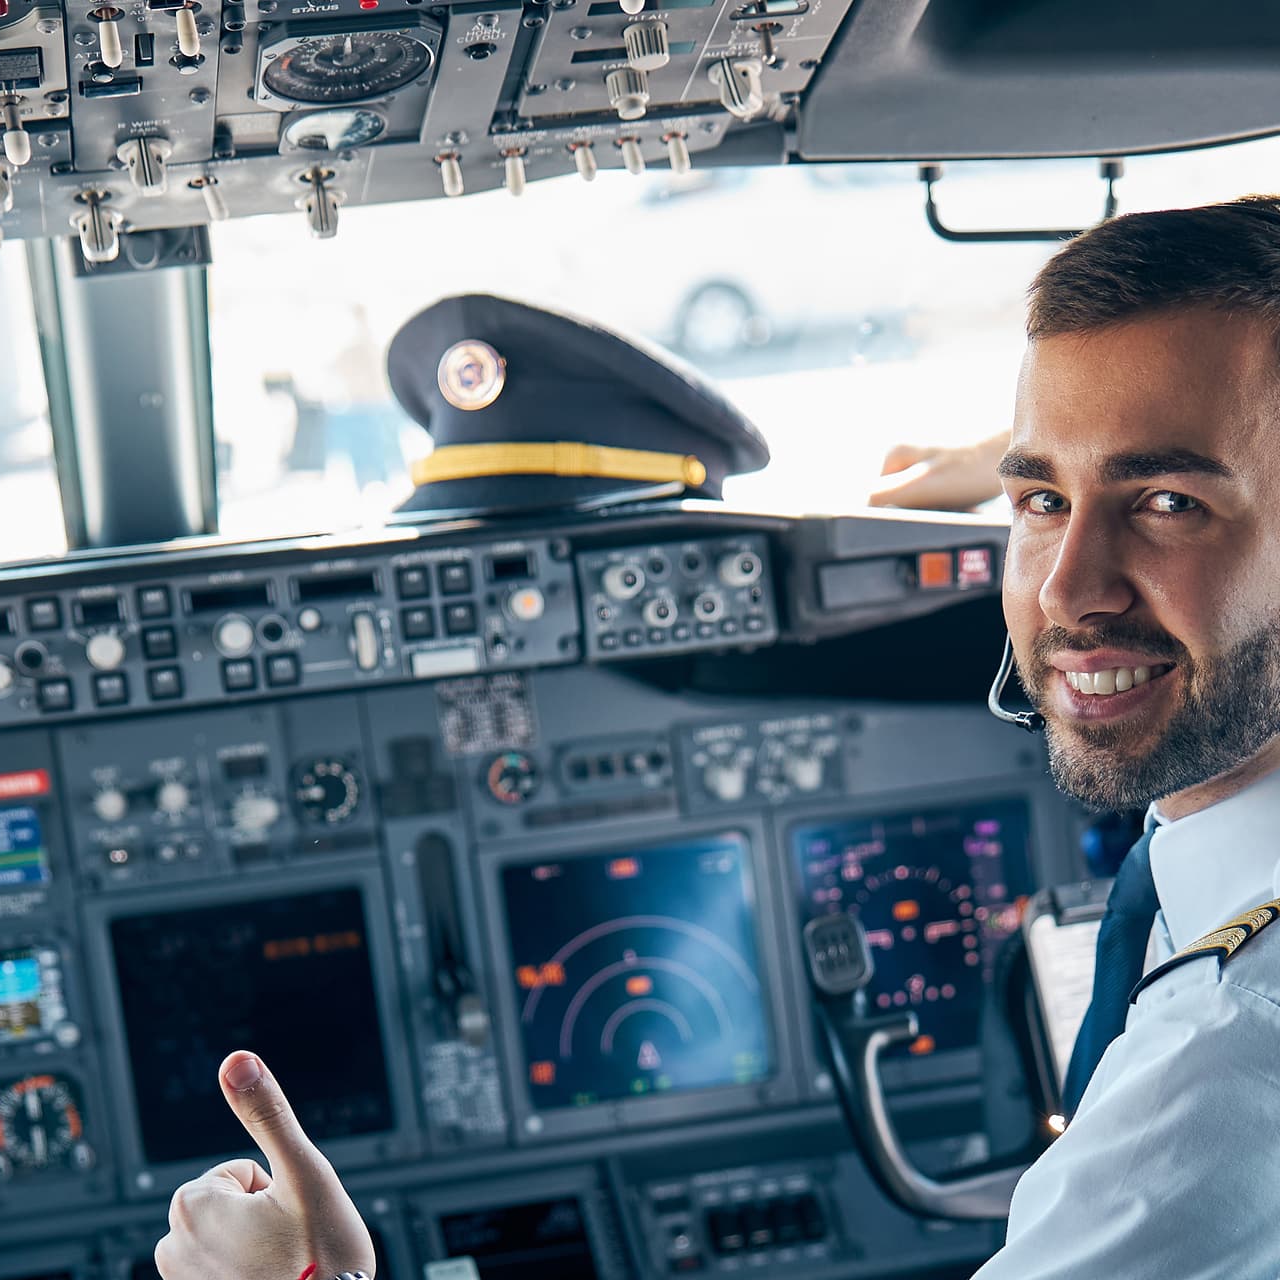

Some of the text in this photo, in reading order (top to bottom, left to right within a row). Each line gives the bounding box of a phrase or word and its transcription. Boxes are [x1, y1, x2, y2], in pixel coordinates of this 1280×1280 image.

[292, 4, 339, 14] STATUS
[648, 12, 669, 20] ALT
[74, 49, 128, 59] ATTD
[131, 119, 171, 128] WIPER
